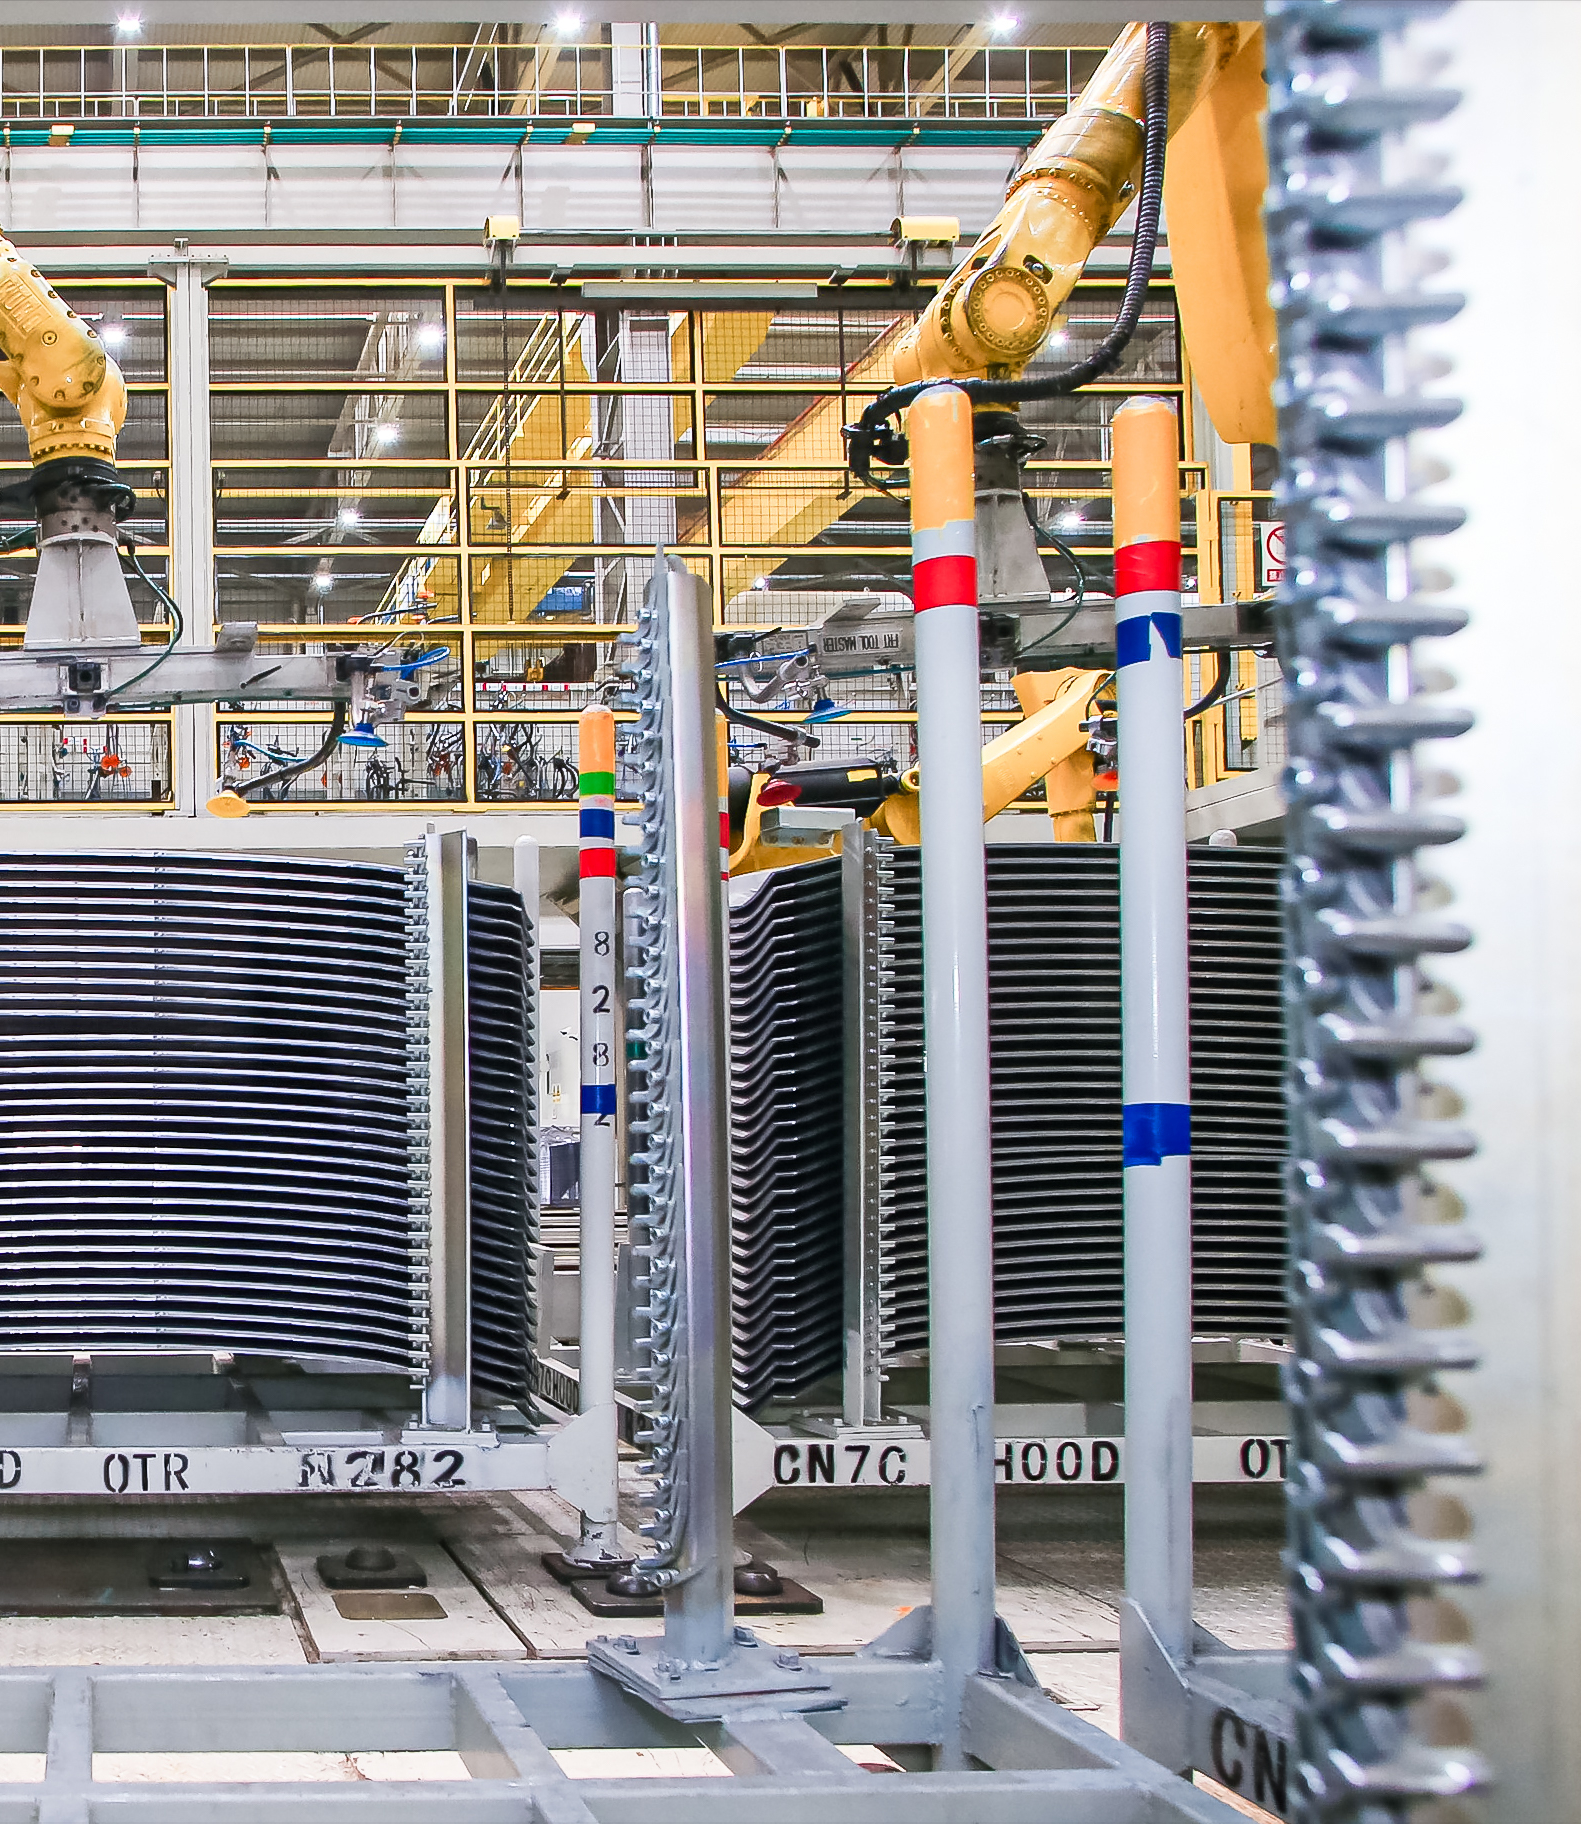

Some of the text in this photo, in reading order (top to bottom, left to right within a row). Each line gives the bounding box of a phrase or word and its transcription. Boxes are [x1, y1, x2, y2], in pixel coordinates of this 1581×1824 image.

[822, 635, 857, 652] MASTER
[857, 634, 880, 650] TOOL
[103, 1452, 190, 1494] OTR
[773, 1443, 908, 1485] CN7C
[995, 1440, 1120, 1482] HOOD
